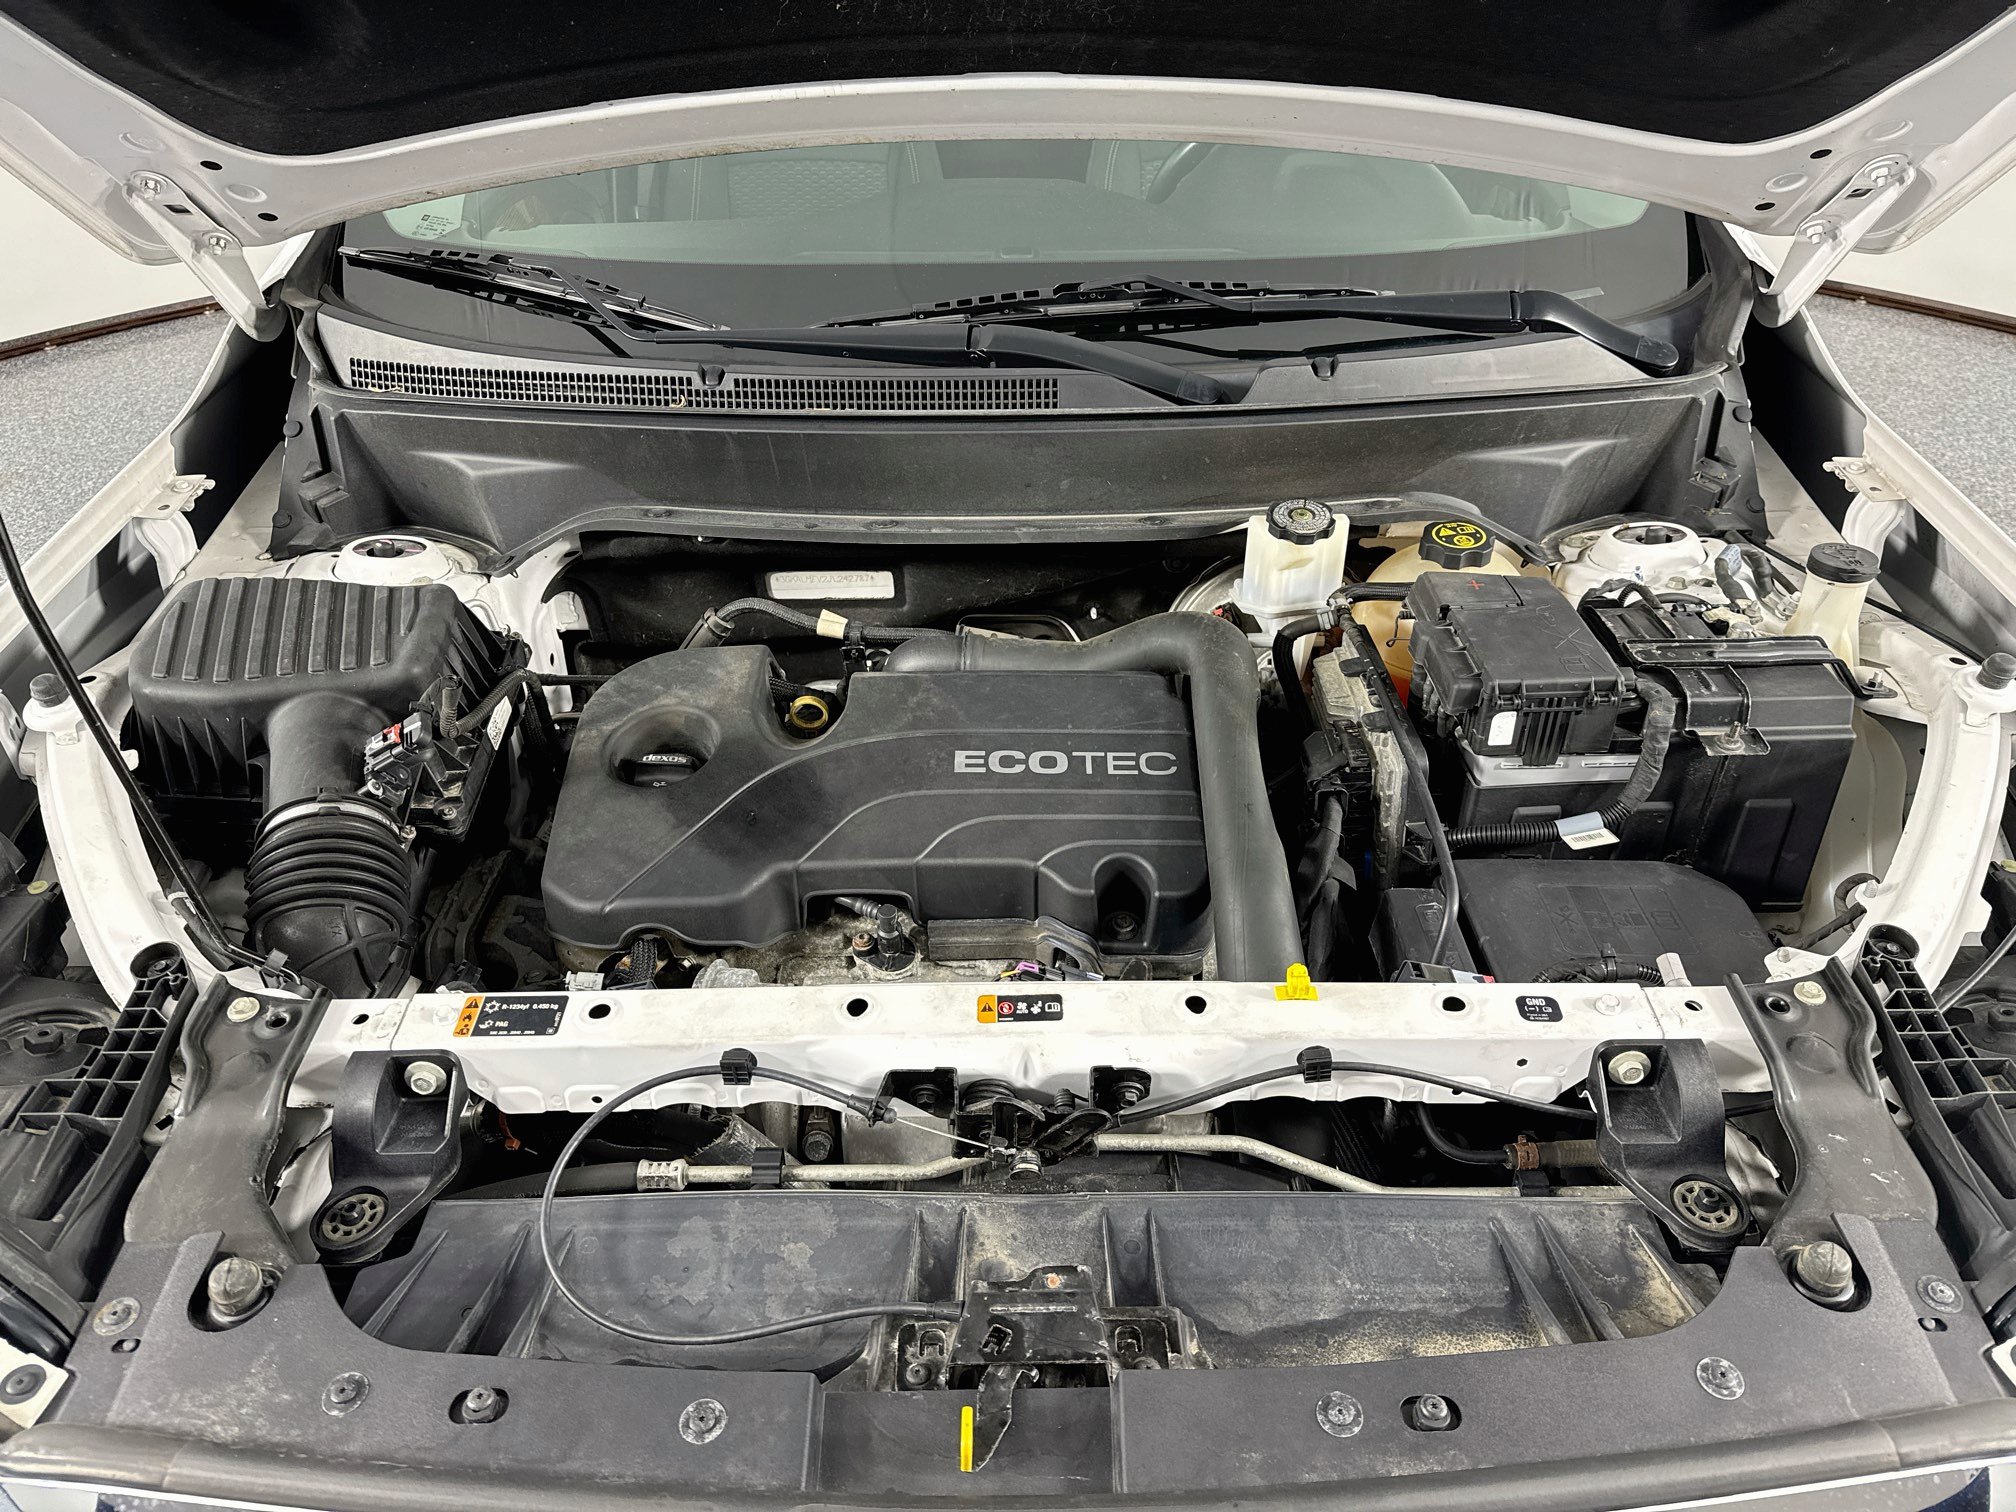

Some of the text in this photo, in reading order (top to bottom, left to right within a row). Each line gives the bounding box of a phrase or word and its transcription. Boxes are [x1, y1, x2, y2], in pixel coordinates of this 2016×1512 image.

[642, 754, 687, 763] dexos
[954, 750, 1178, 775] ECOTEC
[1525, 998, 1546, 1006] GND
